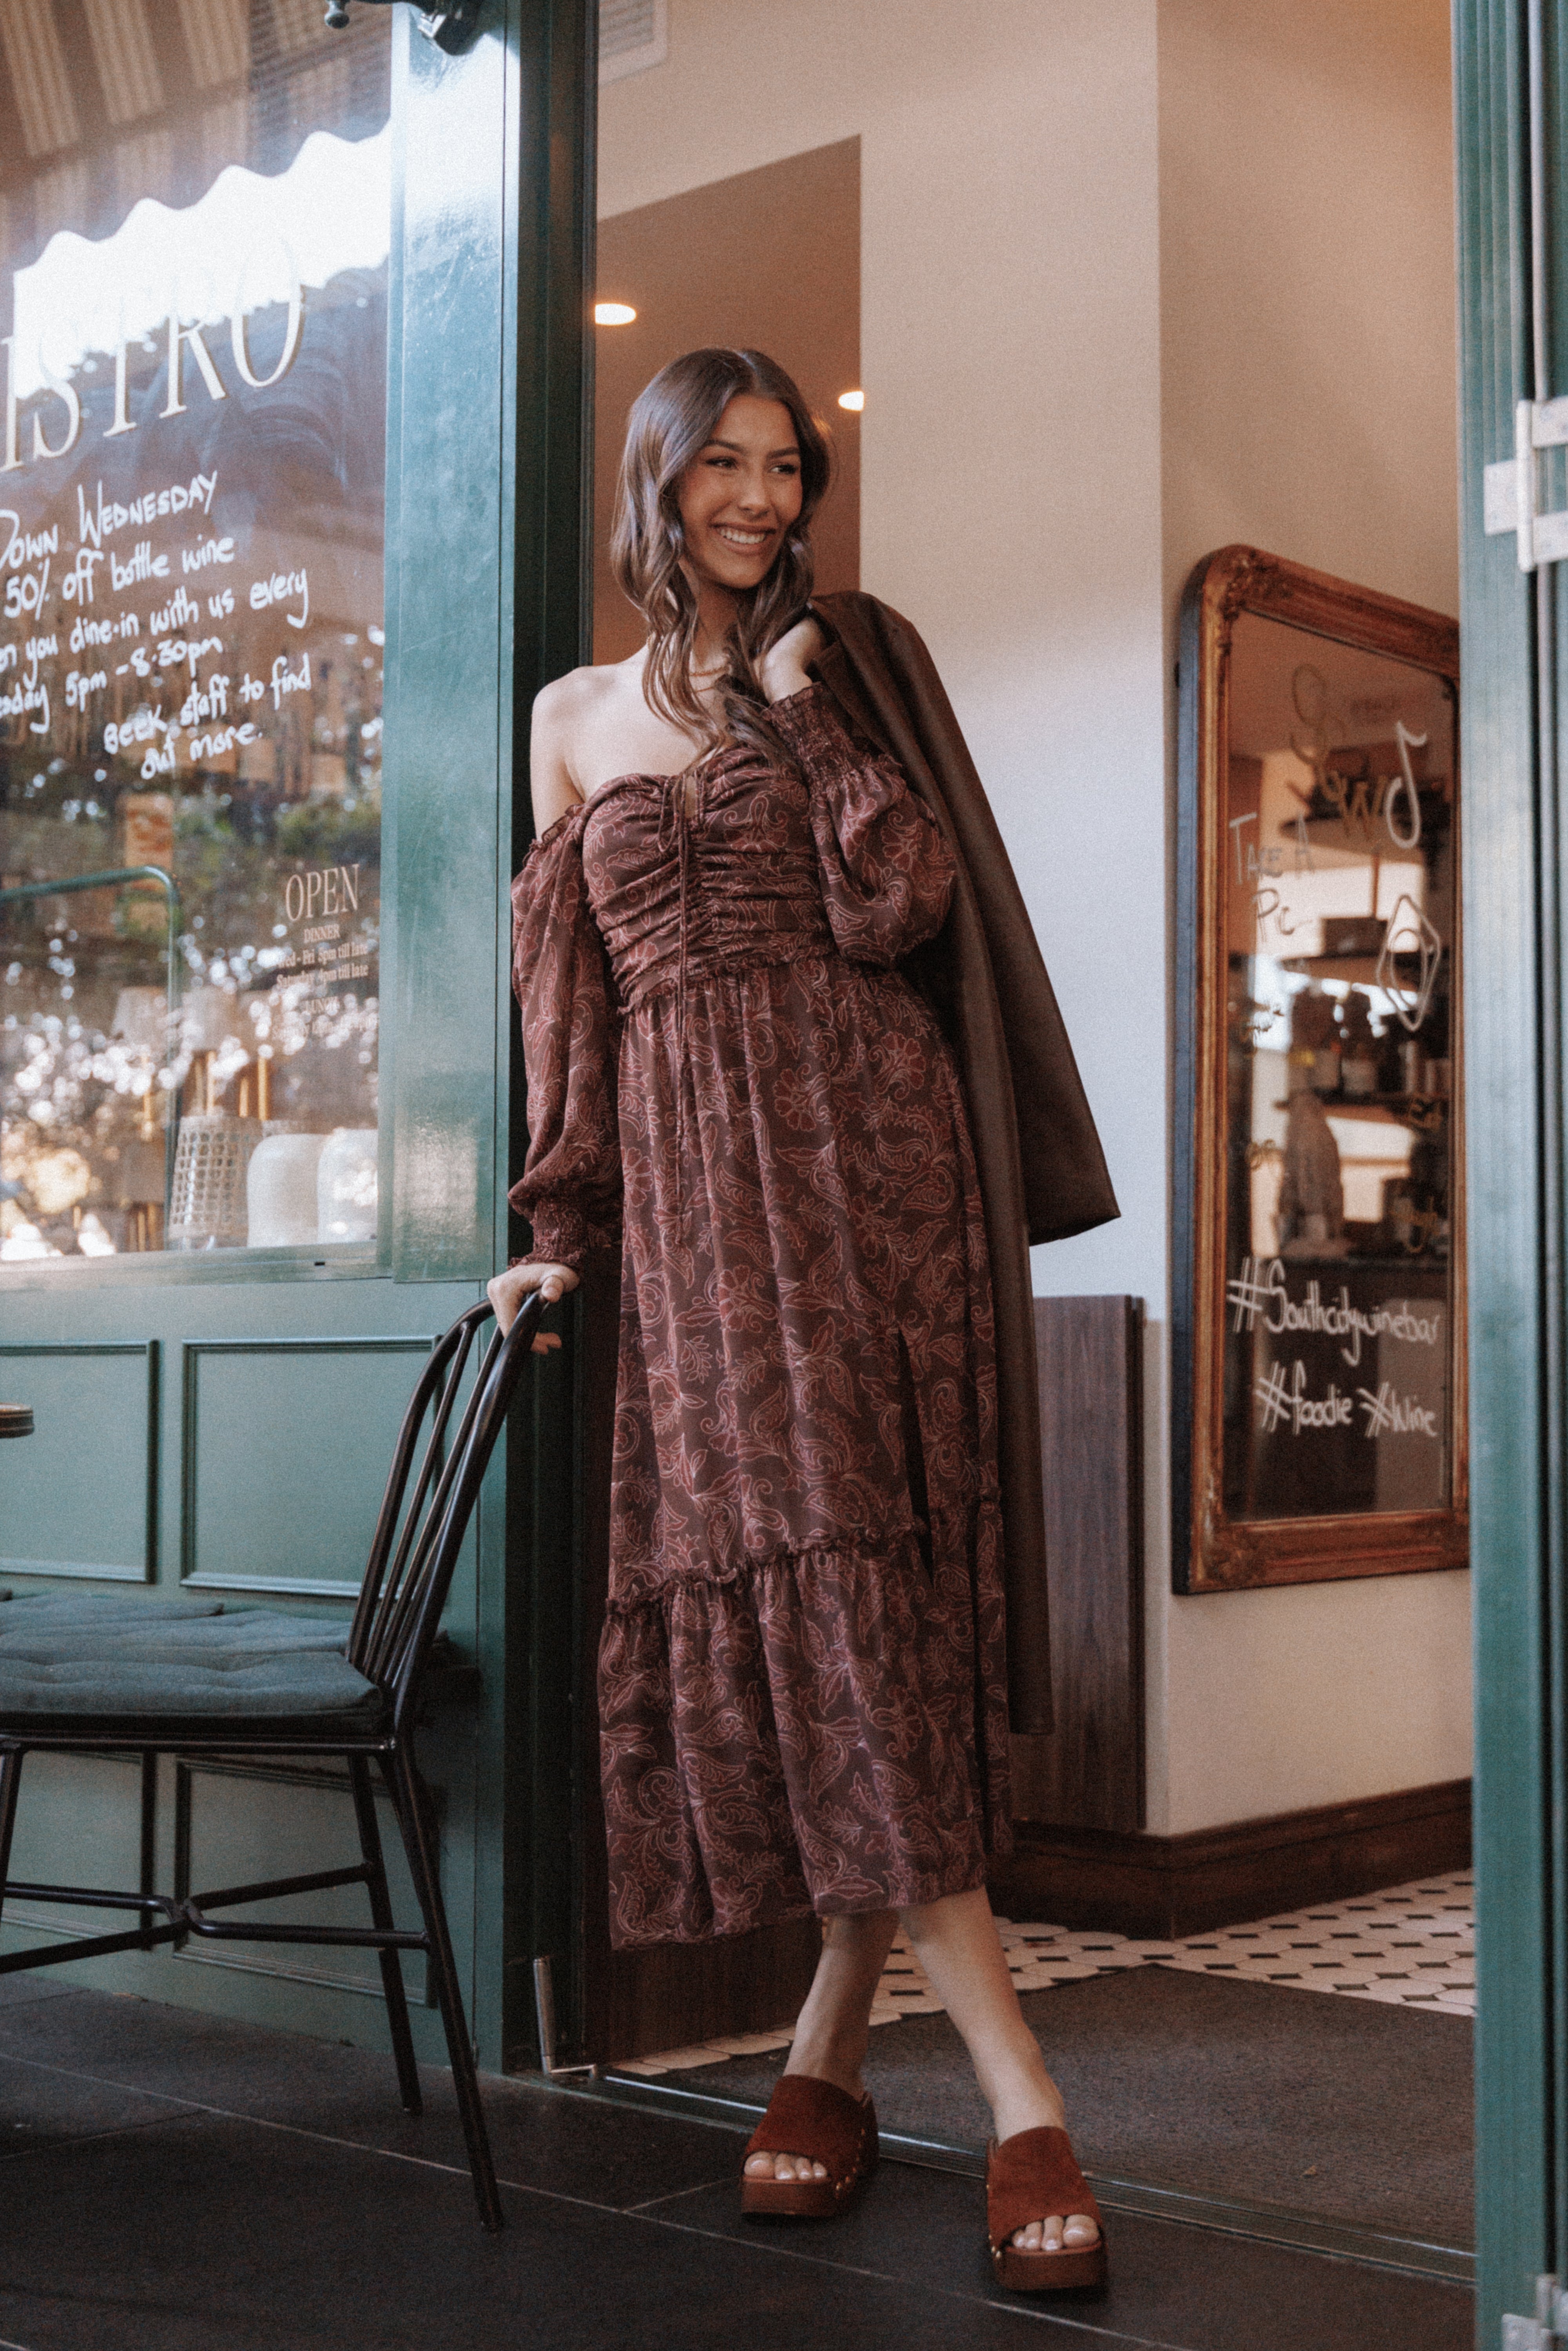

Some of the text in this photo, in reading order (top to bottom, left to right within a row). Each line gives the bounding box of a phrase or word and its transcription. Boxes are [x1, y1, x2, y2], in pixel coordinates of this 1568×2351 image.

[4, 533, 235, 620] 50% off bottle wine
[23, 633, 58, 691] you
[150, 585, 199, 636] with
[208, 588, 235, 619] us
[250, 568, 308, 629] every
[65, 670, 107, 713] 5pm
[180, 673, 230, 726] staff
[239, 673, 265, 704] to
[270, 652, 312, 711] find
[140, 731, 176, 780] out
[285, 863, 359, 921] OPEN
[303, 923, 341, 943] DINNER
[303, 948, 315, 965] Fri
[337, 942, 350, 959] till
[337, 963, 351, 980] till
[351, 962, 369, 978] late
